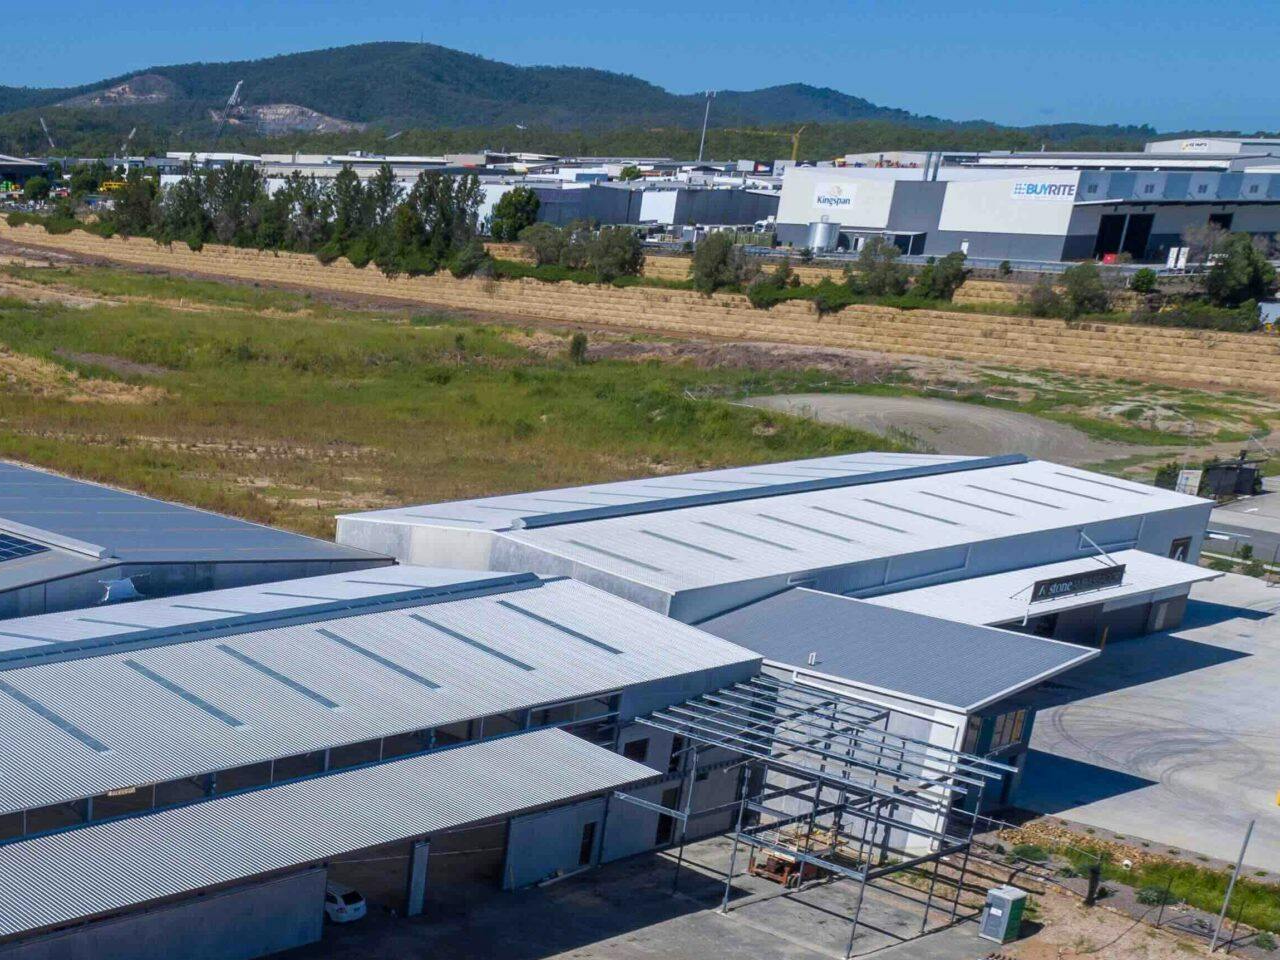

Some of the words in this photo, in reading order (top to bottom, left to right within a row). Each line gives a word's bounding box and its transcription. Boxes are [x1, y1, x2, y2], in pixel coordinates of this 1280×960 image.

[1026, 183, 1075, 195] BUYRITE
[817, 196, 850, 206] Kingspan
[1050, 581, 1073, 594] stone
